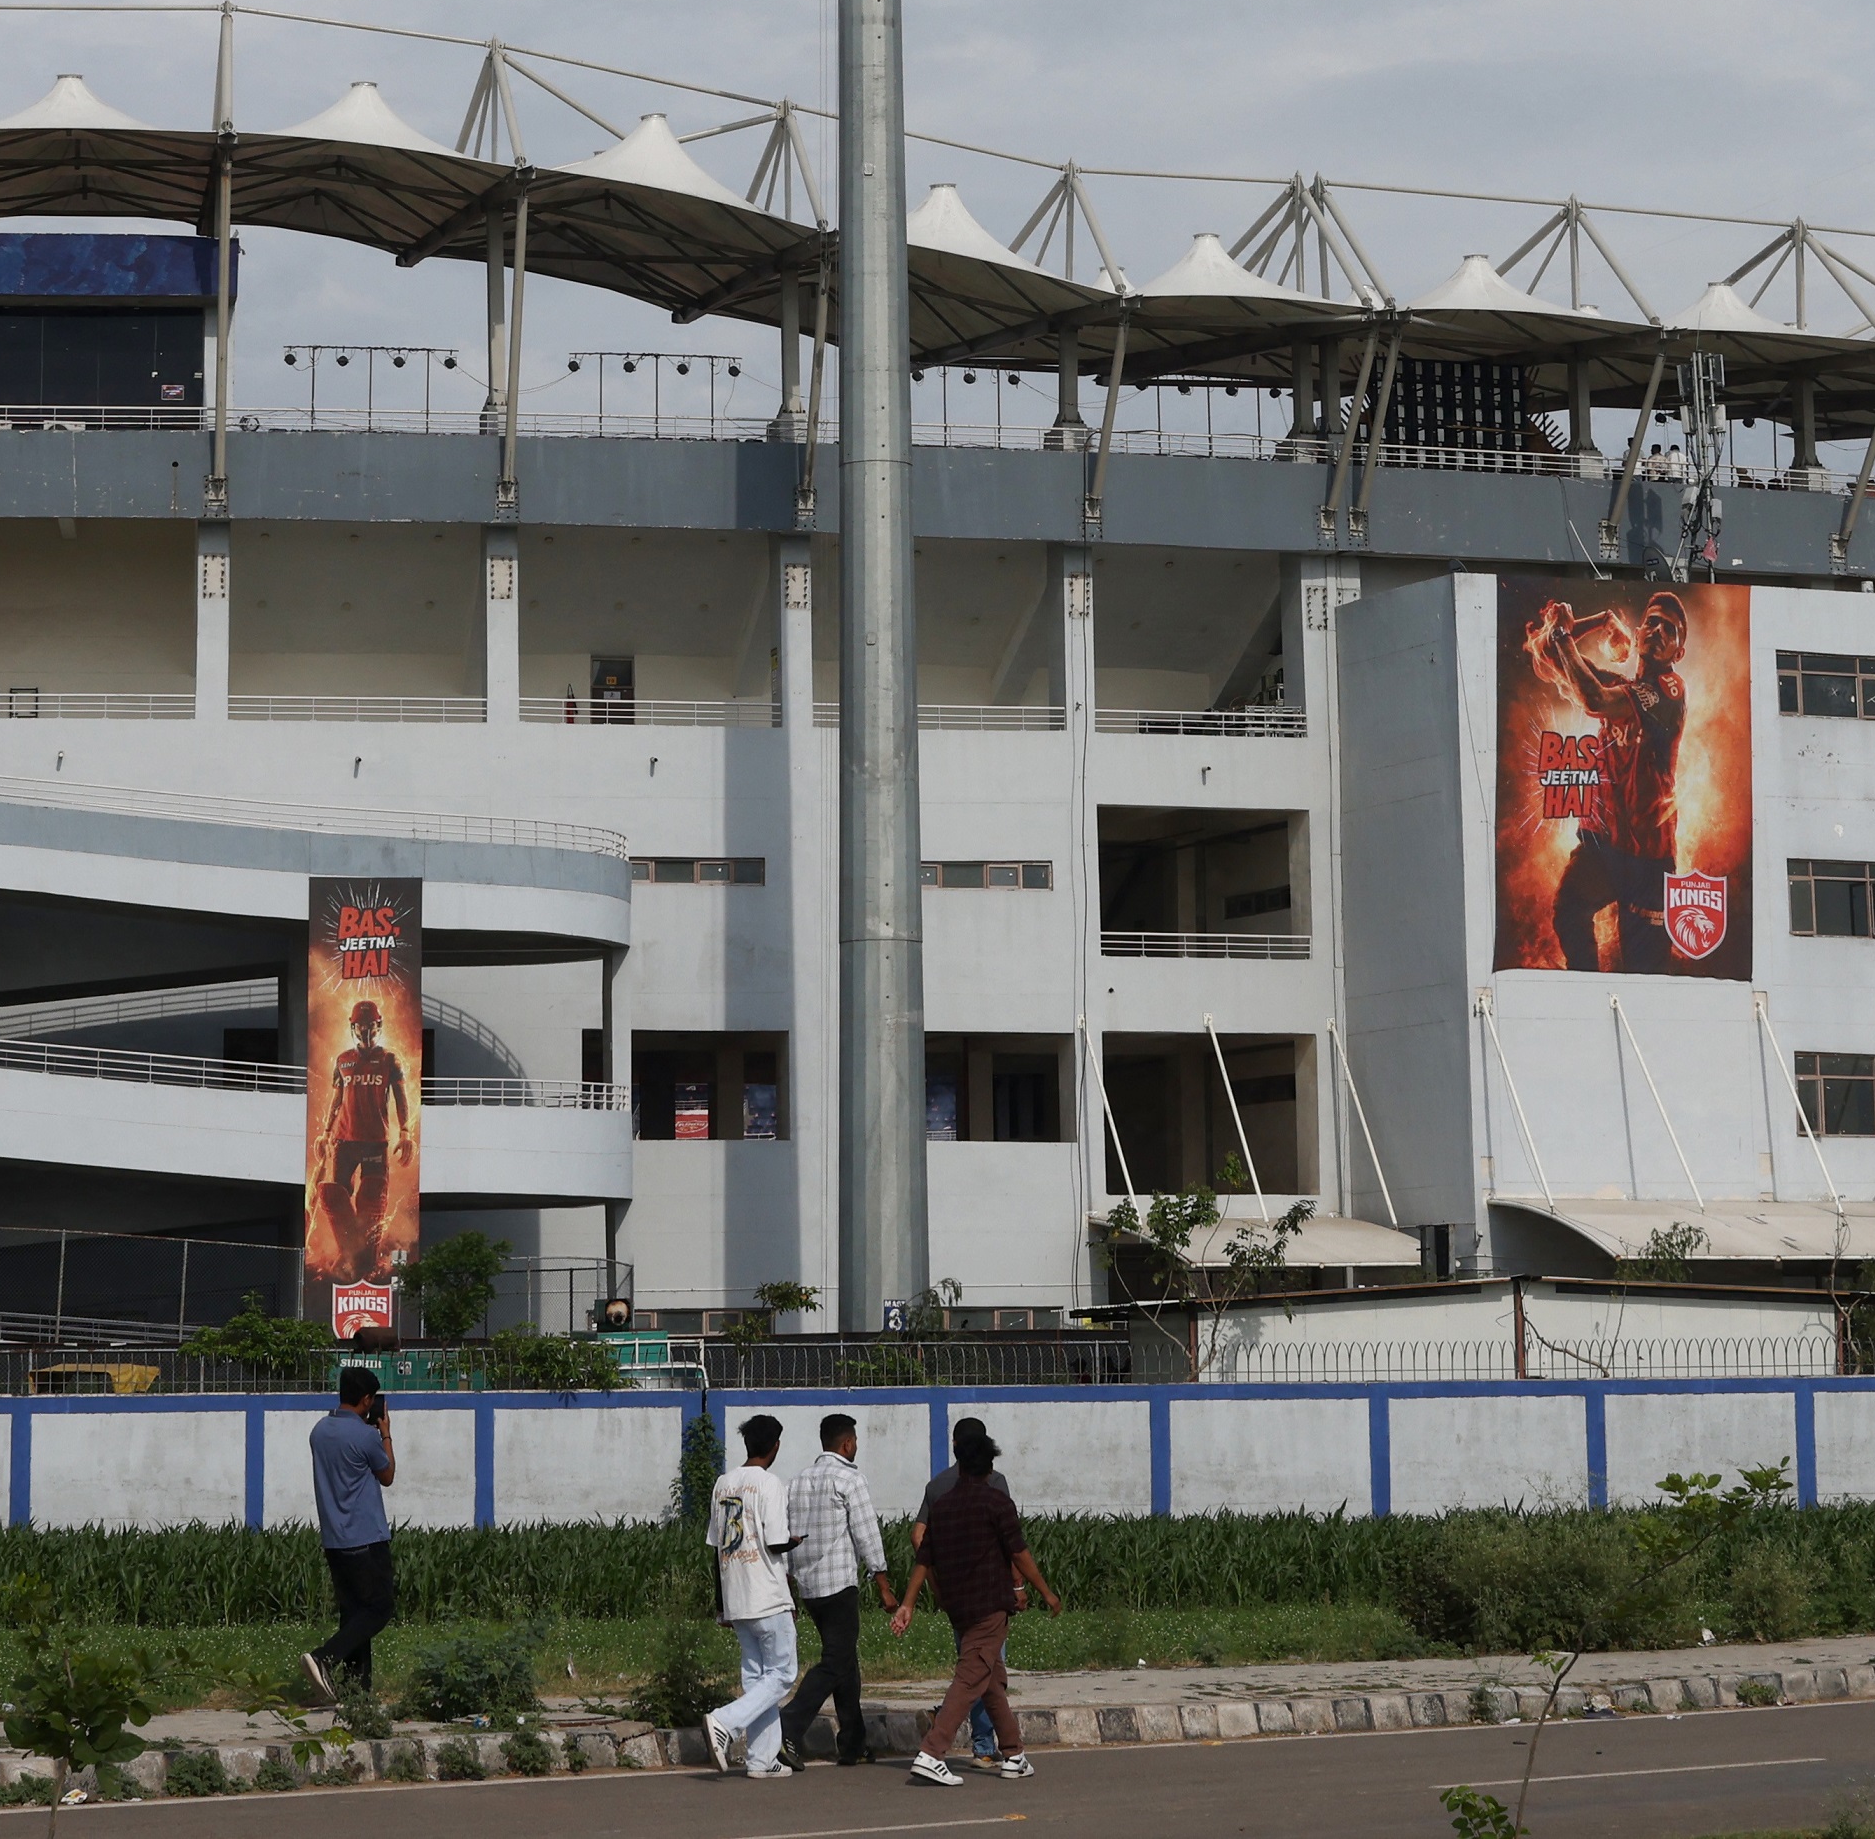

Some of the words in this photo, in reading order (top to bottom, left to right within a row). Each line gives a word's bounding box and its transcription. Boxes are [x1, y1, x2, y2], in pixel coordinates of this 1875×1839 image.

[1539, 731, 1606, 773] BAS,
[1540, 769, 1600, 785] JEETNA
[1543, 785, 1593, 819] HAI
[1680, 880, 1711, 889] PUNJAB
[1669, 887, 1723, 912] KINGS
[338, 906, 401, 940] BAS,
[339, 935, 396, 951] JEETNA
[342, 948, 390, 979] HAI
[352, 1074, 383, 1086] PLUS
[337, 1296, 388, 1315] KINGS
[339, 1358, 382, 1369] SUDHIR
